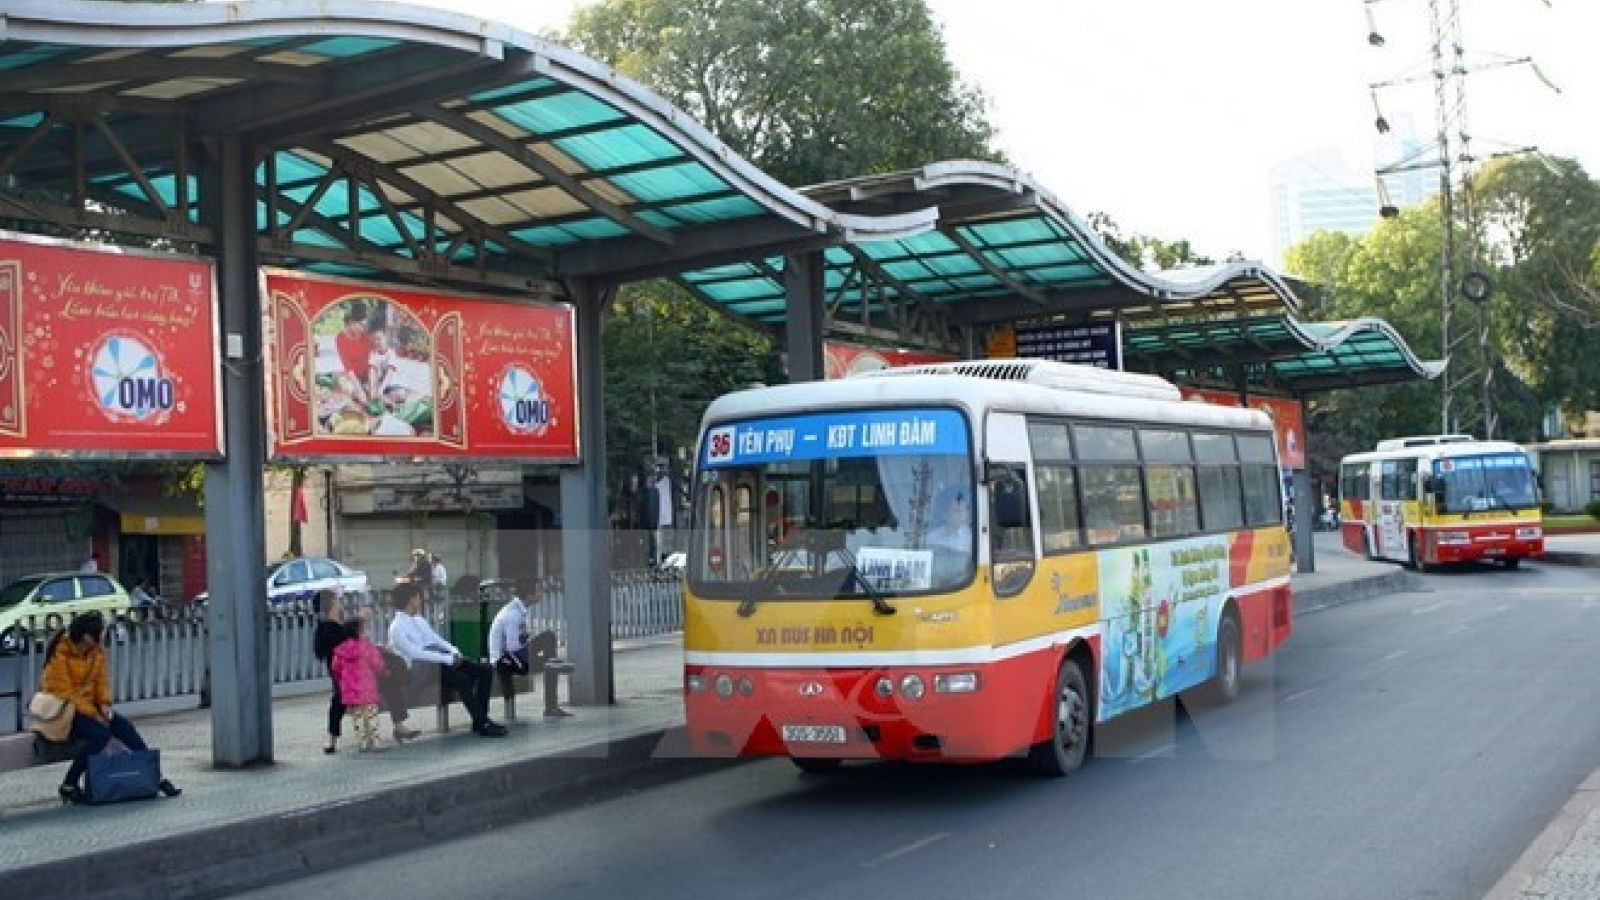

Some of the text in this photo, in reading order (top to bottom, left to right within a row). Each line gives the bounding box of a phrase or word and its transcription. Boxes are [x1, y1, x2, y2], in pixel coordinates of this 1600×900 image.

[118, 376, 174, 411] OMO
[514, 399, 549, 425] OMO
[738, 427, 765, 455] YÊN
[766, 428, 795, 457] PHỤ
[862, 420, 895, 447] LINH
[899, 416, 937, 446] ĐÀM
[780, 627, 809, 645] BUS
[841, 621, 874, 650] NỘI
